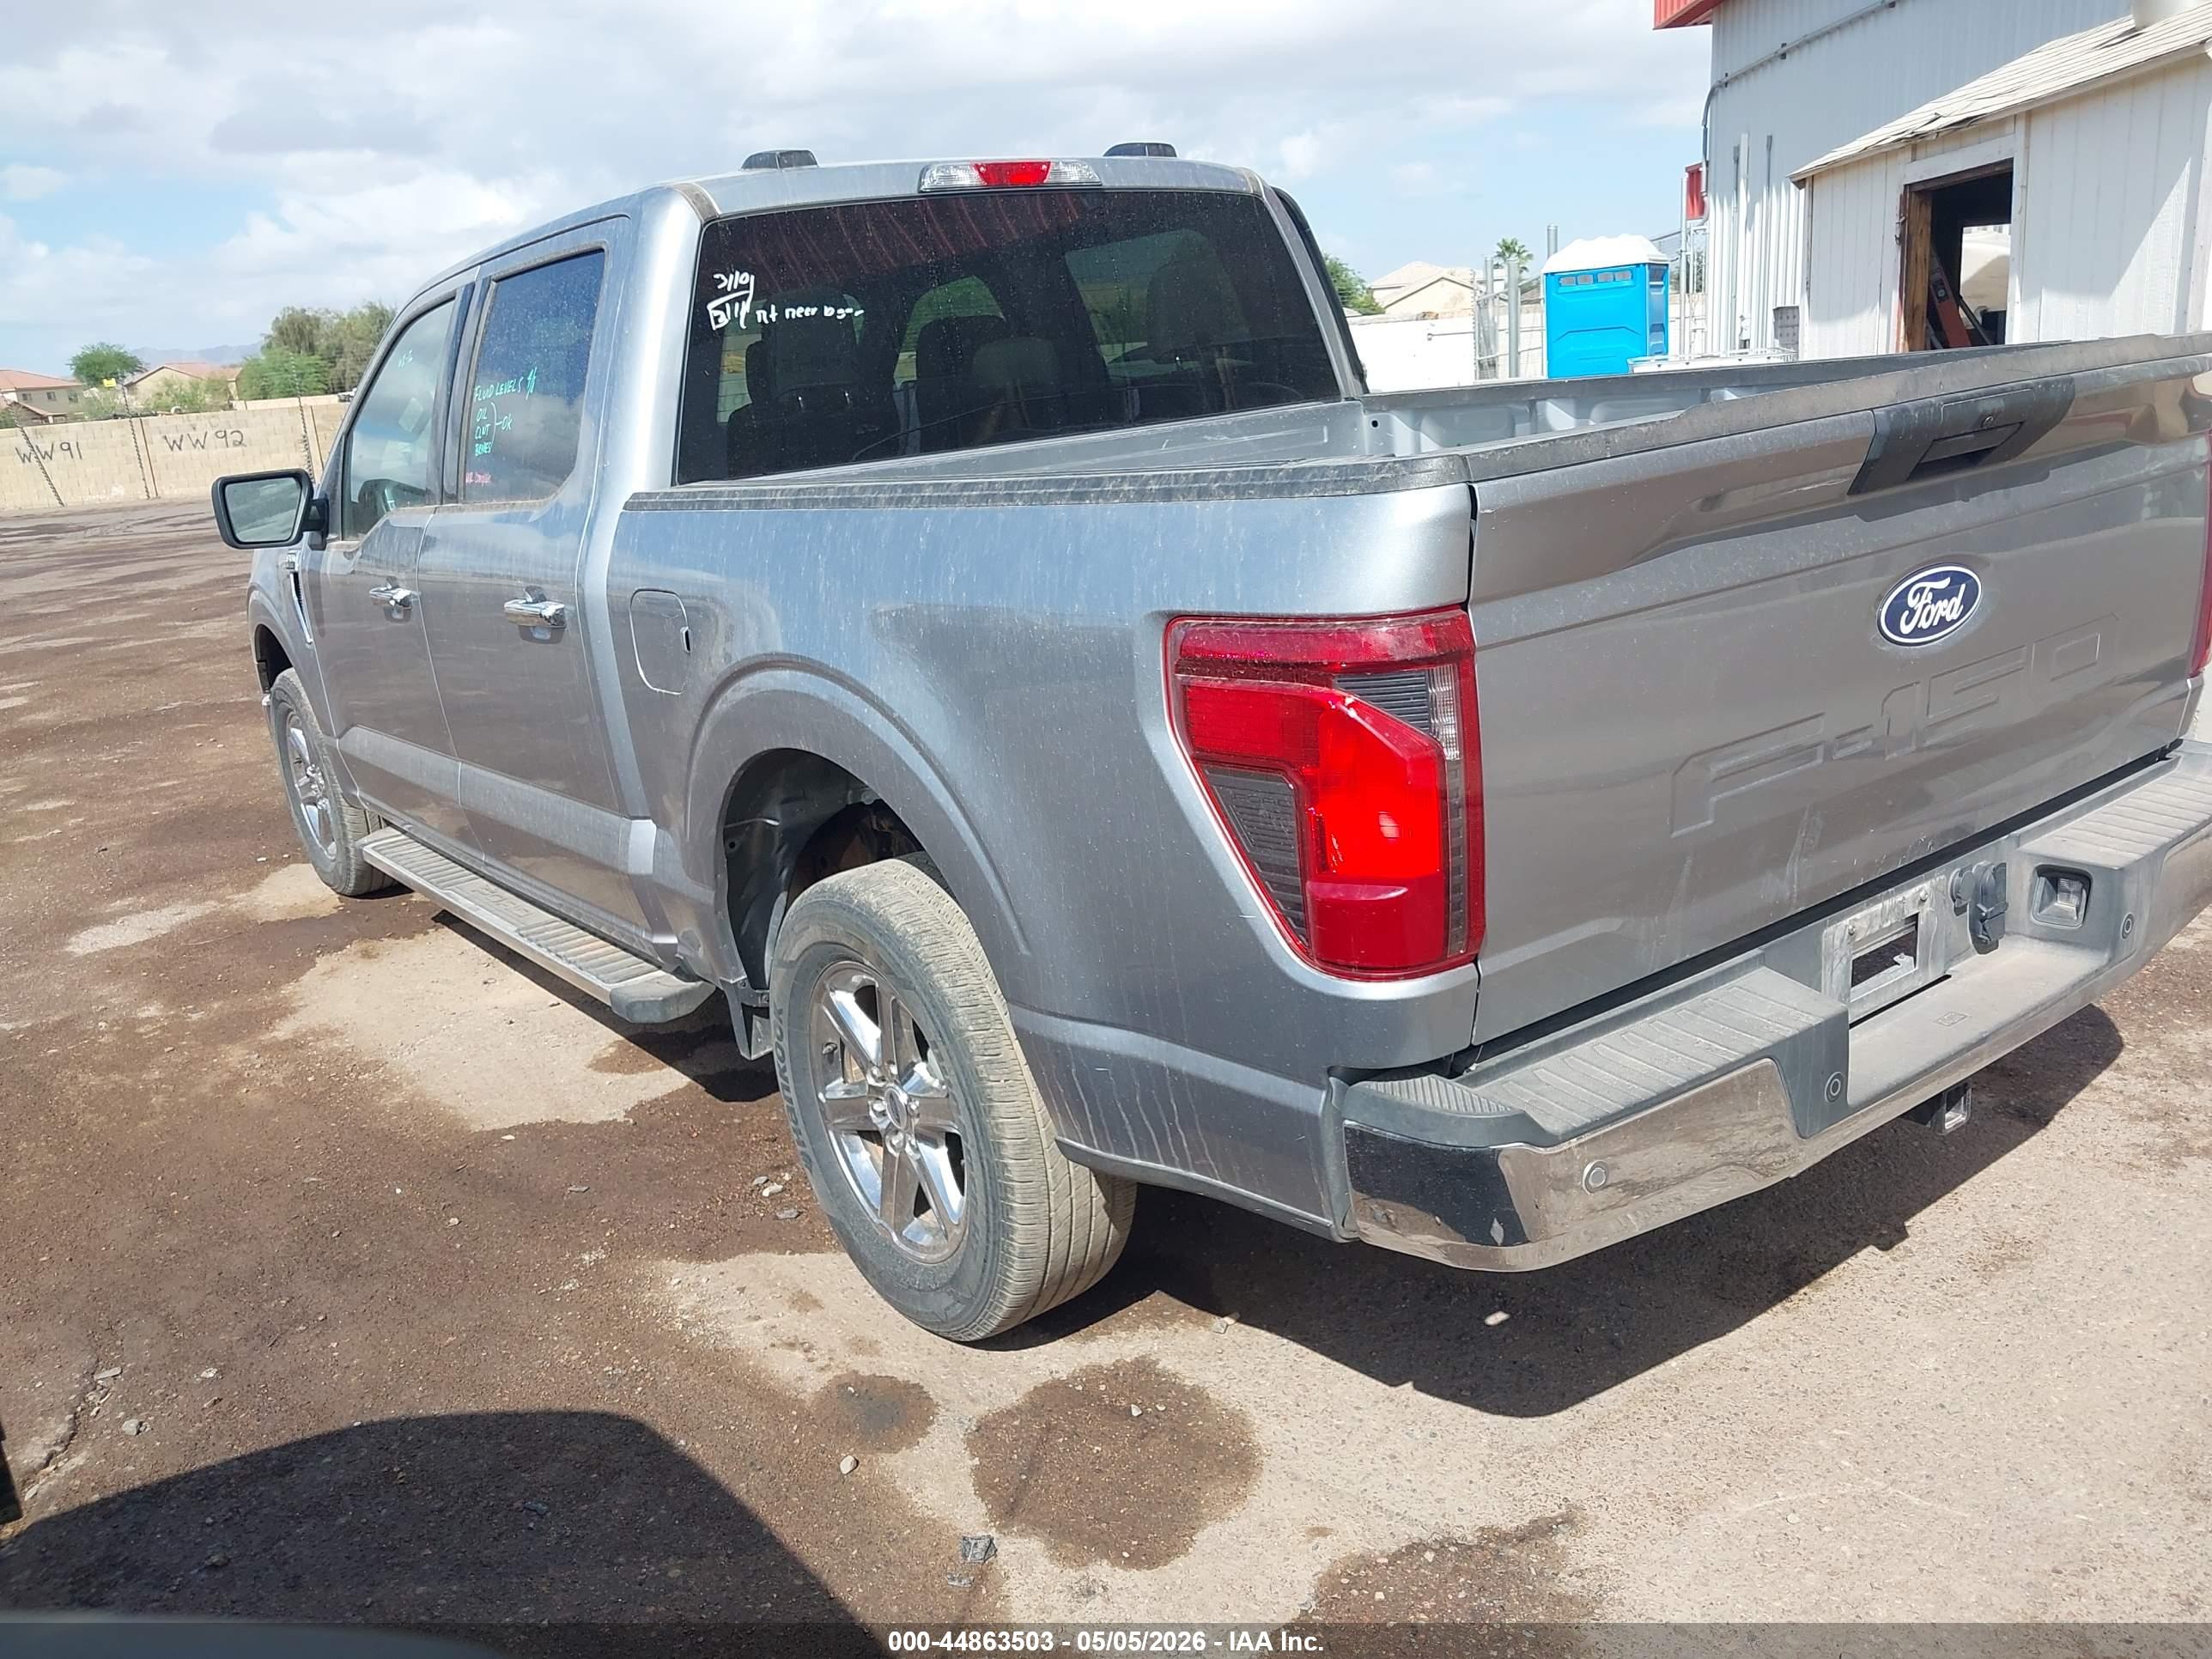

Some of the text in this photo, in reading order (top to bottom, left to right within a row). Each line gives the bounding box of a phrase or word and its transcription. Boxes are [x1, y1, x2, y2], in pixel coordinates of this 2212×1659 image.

[495, 376, 524, 397] LEVELS
[476, 407, 488, 422] OIL
[215, 428, 246, 449] 92
[59, 441, 83, 460] 91
[1899, 576, 1966, 635] Ford
[1667, 611, 2120, 839] F-150
